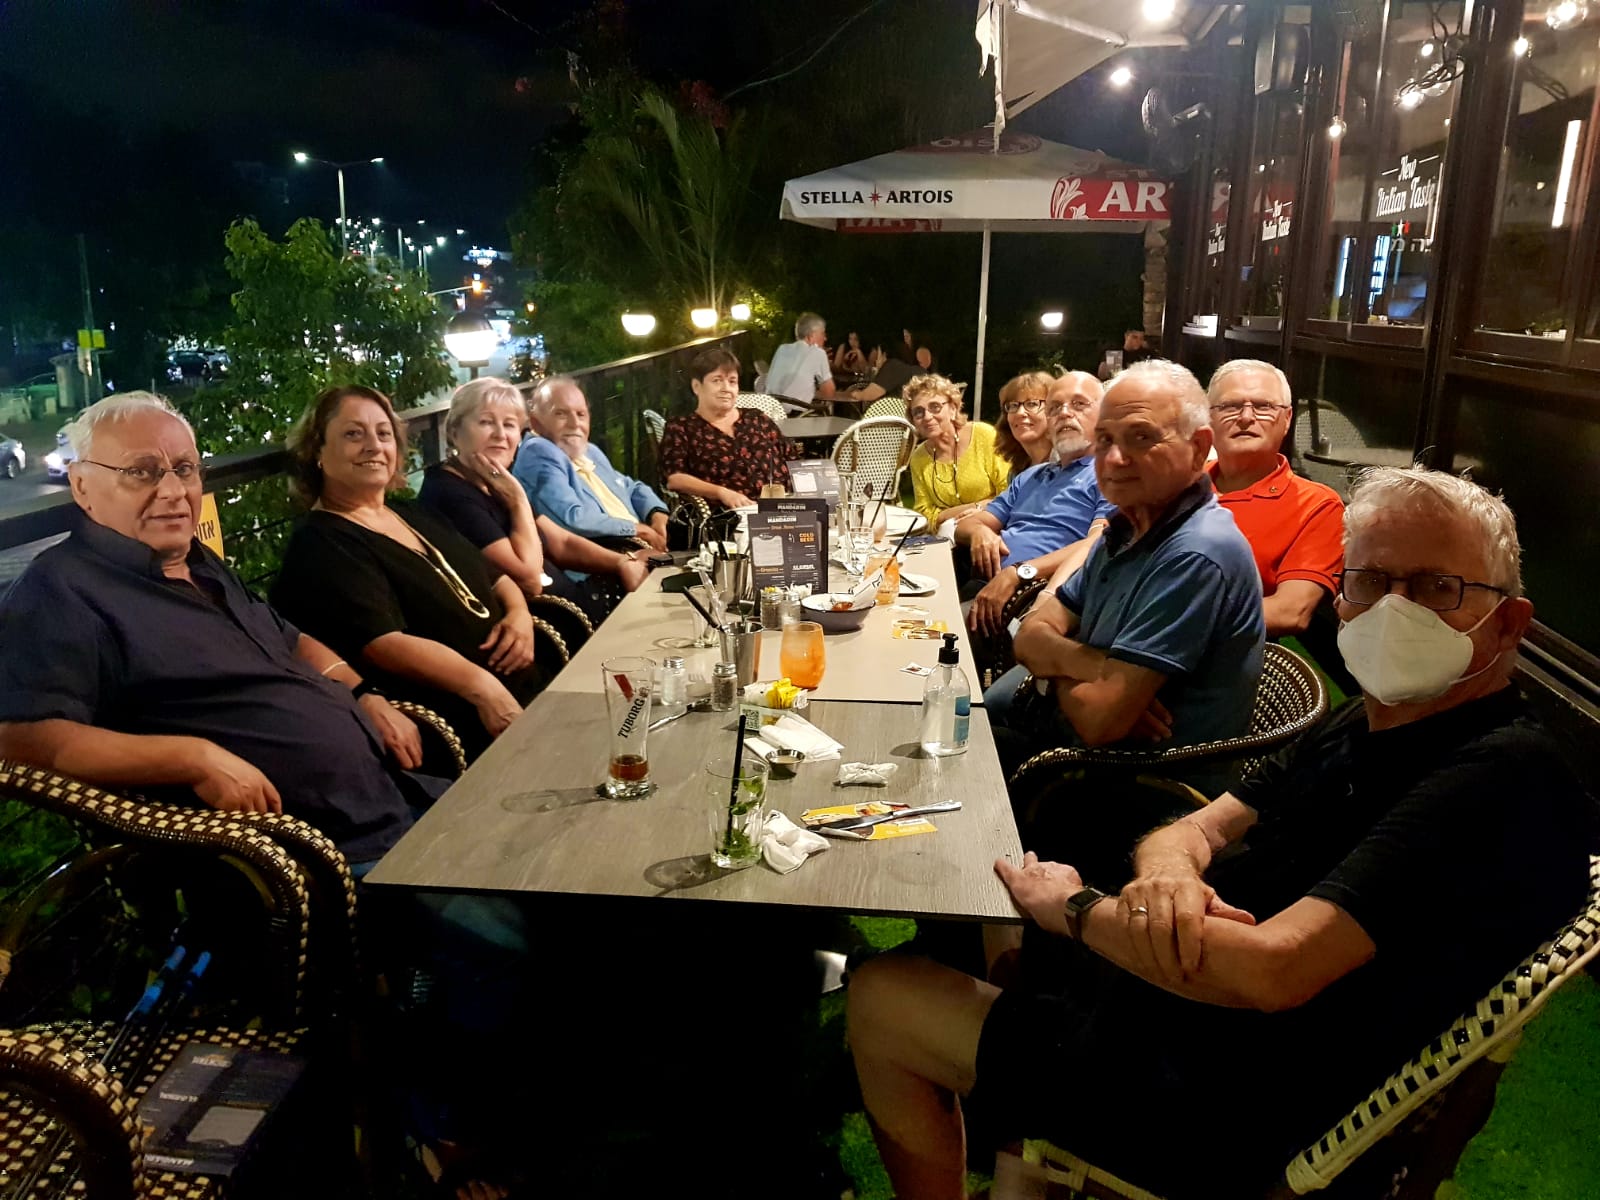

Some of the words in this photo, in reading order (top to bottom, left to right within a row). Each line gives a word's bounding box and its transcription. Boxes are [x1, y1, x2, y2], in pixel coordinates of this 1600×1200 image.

[1398, 155, 1417, 182] New
[800, 191, 864, 204] STELLA
[886, 190, 953, 204] ARTOIS
[1098, 181, 1174, 212] AR
[1376, 187, 1407, 217] Italian
[1410, 176, 1437, 209] Taste
[617, 698, 646, 739] TUBORG
